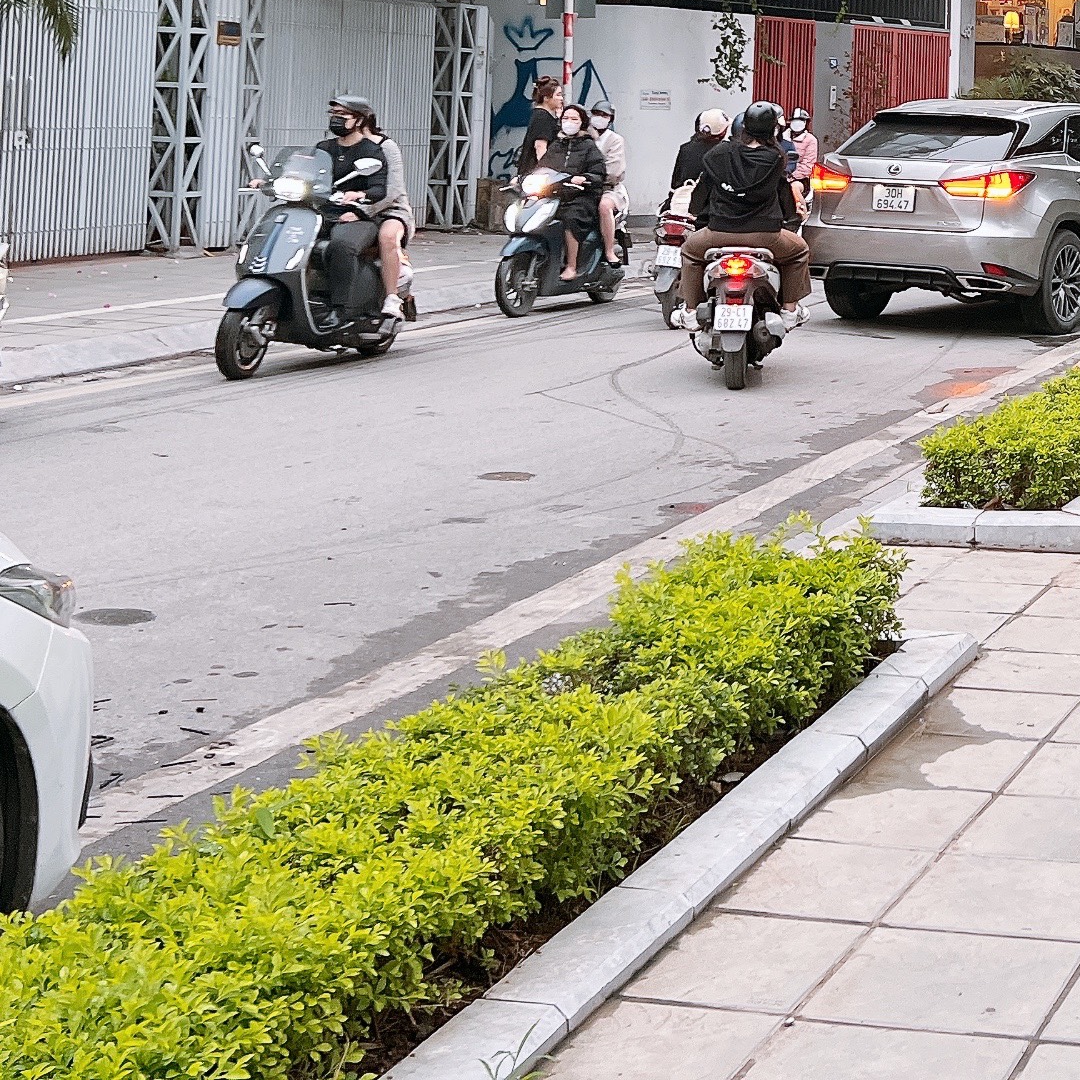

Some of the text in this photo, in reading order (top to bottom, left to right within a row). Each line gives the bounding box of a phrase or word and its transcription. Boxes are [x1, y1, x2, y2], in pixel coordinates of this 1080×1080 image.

[884, 188, 903, 199] 30H
[876, 199, 909, 210] 694.47
[721, 307, 746, 317] 29-C1
